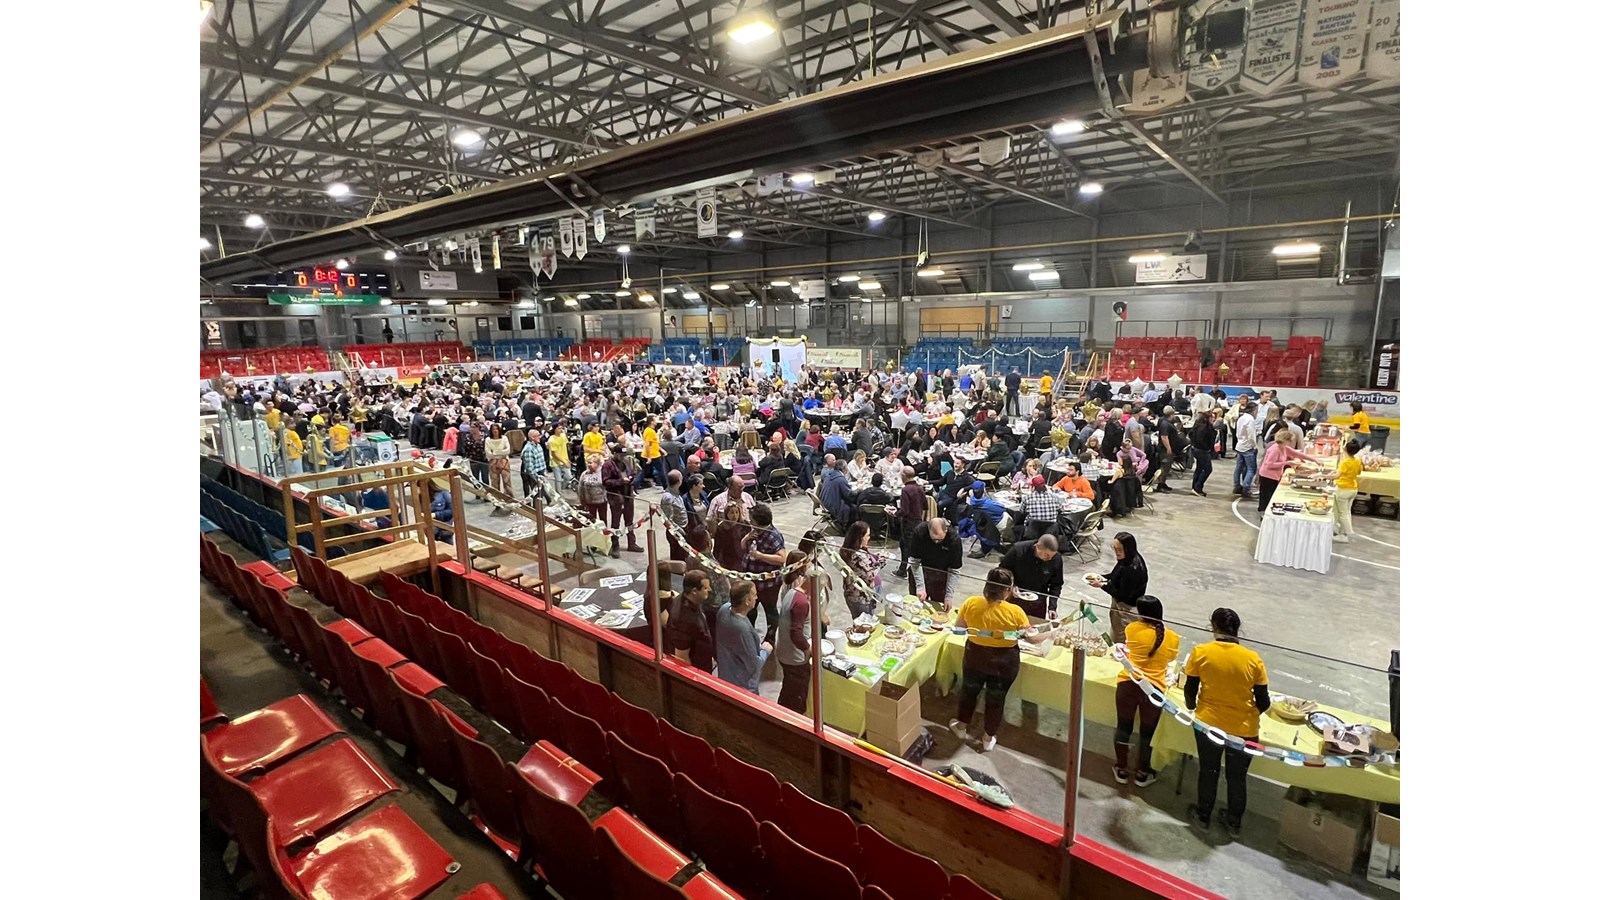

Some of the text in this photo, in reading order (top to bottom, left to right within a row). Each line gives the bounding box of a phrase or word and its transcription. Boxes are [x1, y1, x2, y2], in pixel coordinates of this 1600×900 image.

[1317, 12, 1356, 24] NATIONAL
[1313, 26, 1350, 37] WINDSOR
[1249, 52, 1291, 67] FINALISTE
[1316, 69, 1341, 79] 2003
[540, 236, 554, 250] 79
[299, 275, 306, 287] 0
[315, 269, 338, 281] 8:12
[347, 276, 355, 287] 0
[1339, 391, 1396, 404] valentine
